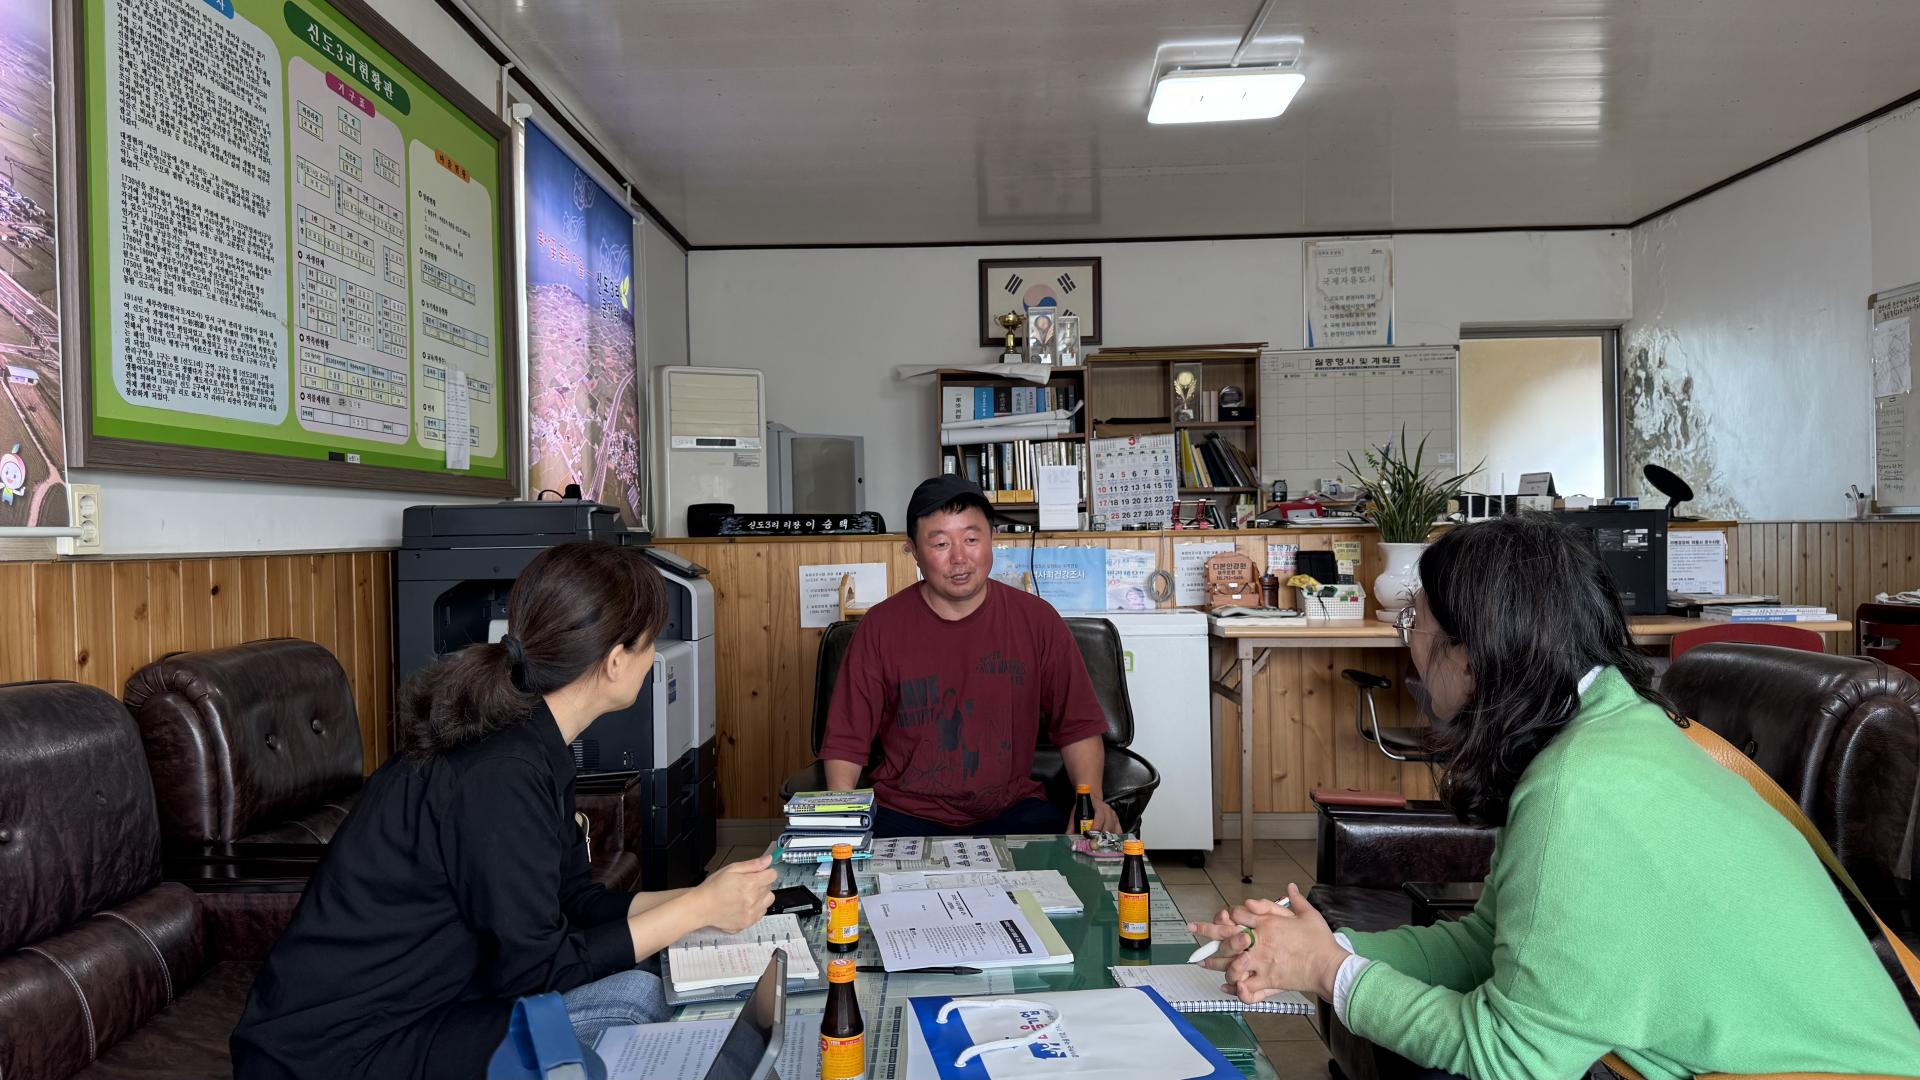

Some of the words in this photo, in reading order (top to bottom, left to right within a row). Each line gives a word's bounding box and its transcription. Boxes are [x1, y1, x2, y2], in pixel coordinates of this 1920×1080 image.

[308, 23, 394, 100] 신도3리현황판
[1328, 266, 1348, 275] 도민이
[1314, 356, 1355, 367] 월중행사
[1371, 356, 1400, 365] 계획표
[748, 520, 780, 530] 신도3리
[783, 520, 800, 530] 리장
